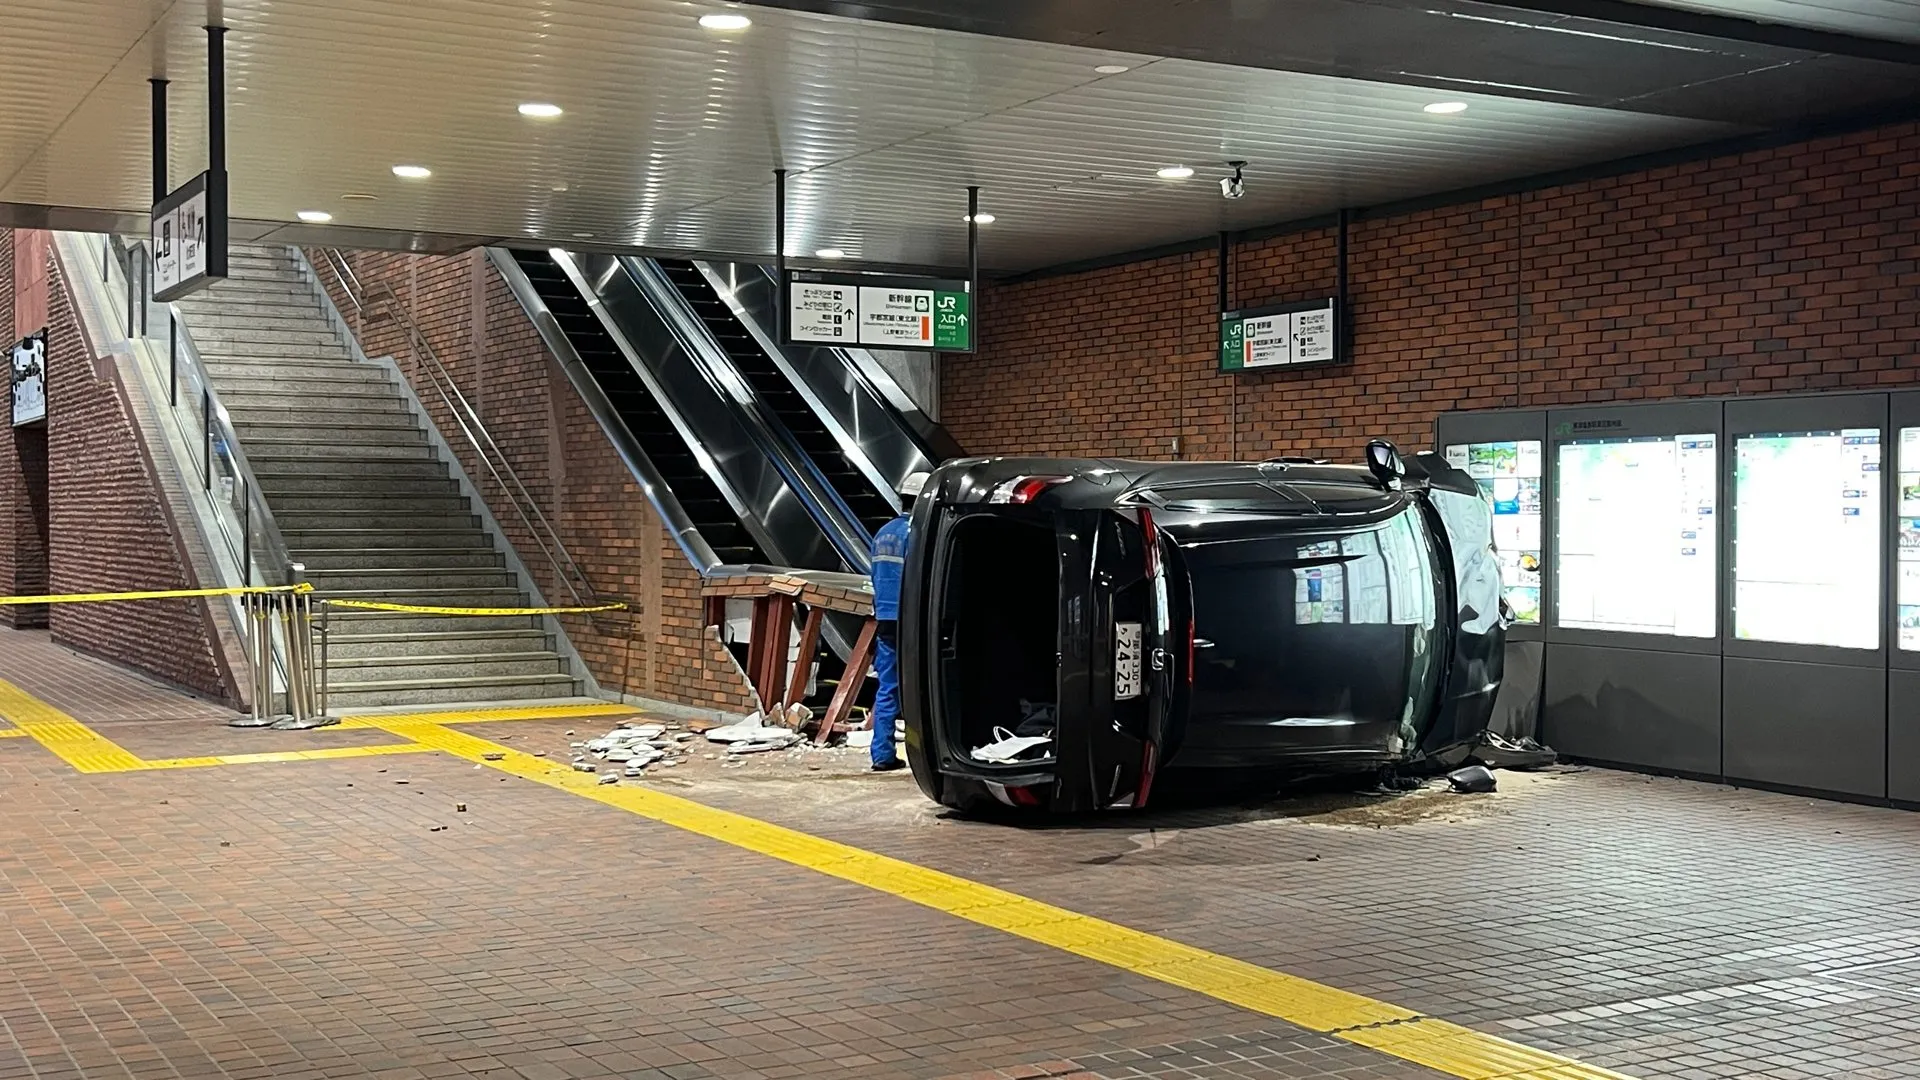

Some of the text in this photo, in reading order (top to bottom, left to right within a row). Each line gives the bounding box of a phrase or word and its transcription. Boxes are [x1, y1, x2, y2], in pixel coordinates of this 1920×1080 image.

[888, 294, 912, 303] 新幹線
[937, 296, 956, 309] JR
[941, 314, 956, 324] 入口
[1230, 324, 1241, 335] JR
[1116, 638, 1131, 695] 24-25
[1131, 662, 1140, 681] 330
